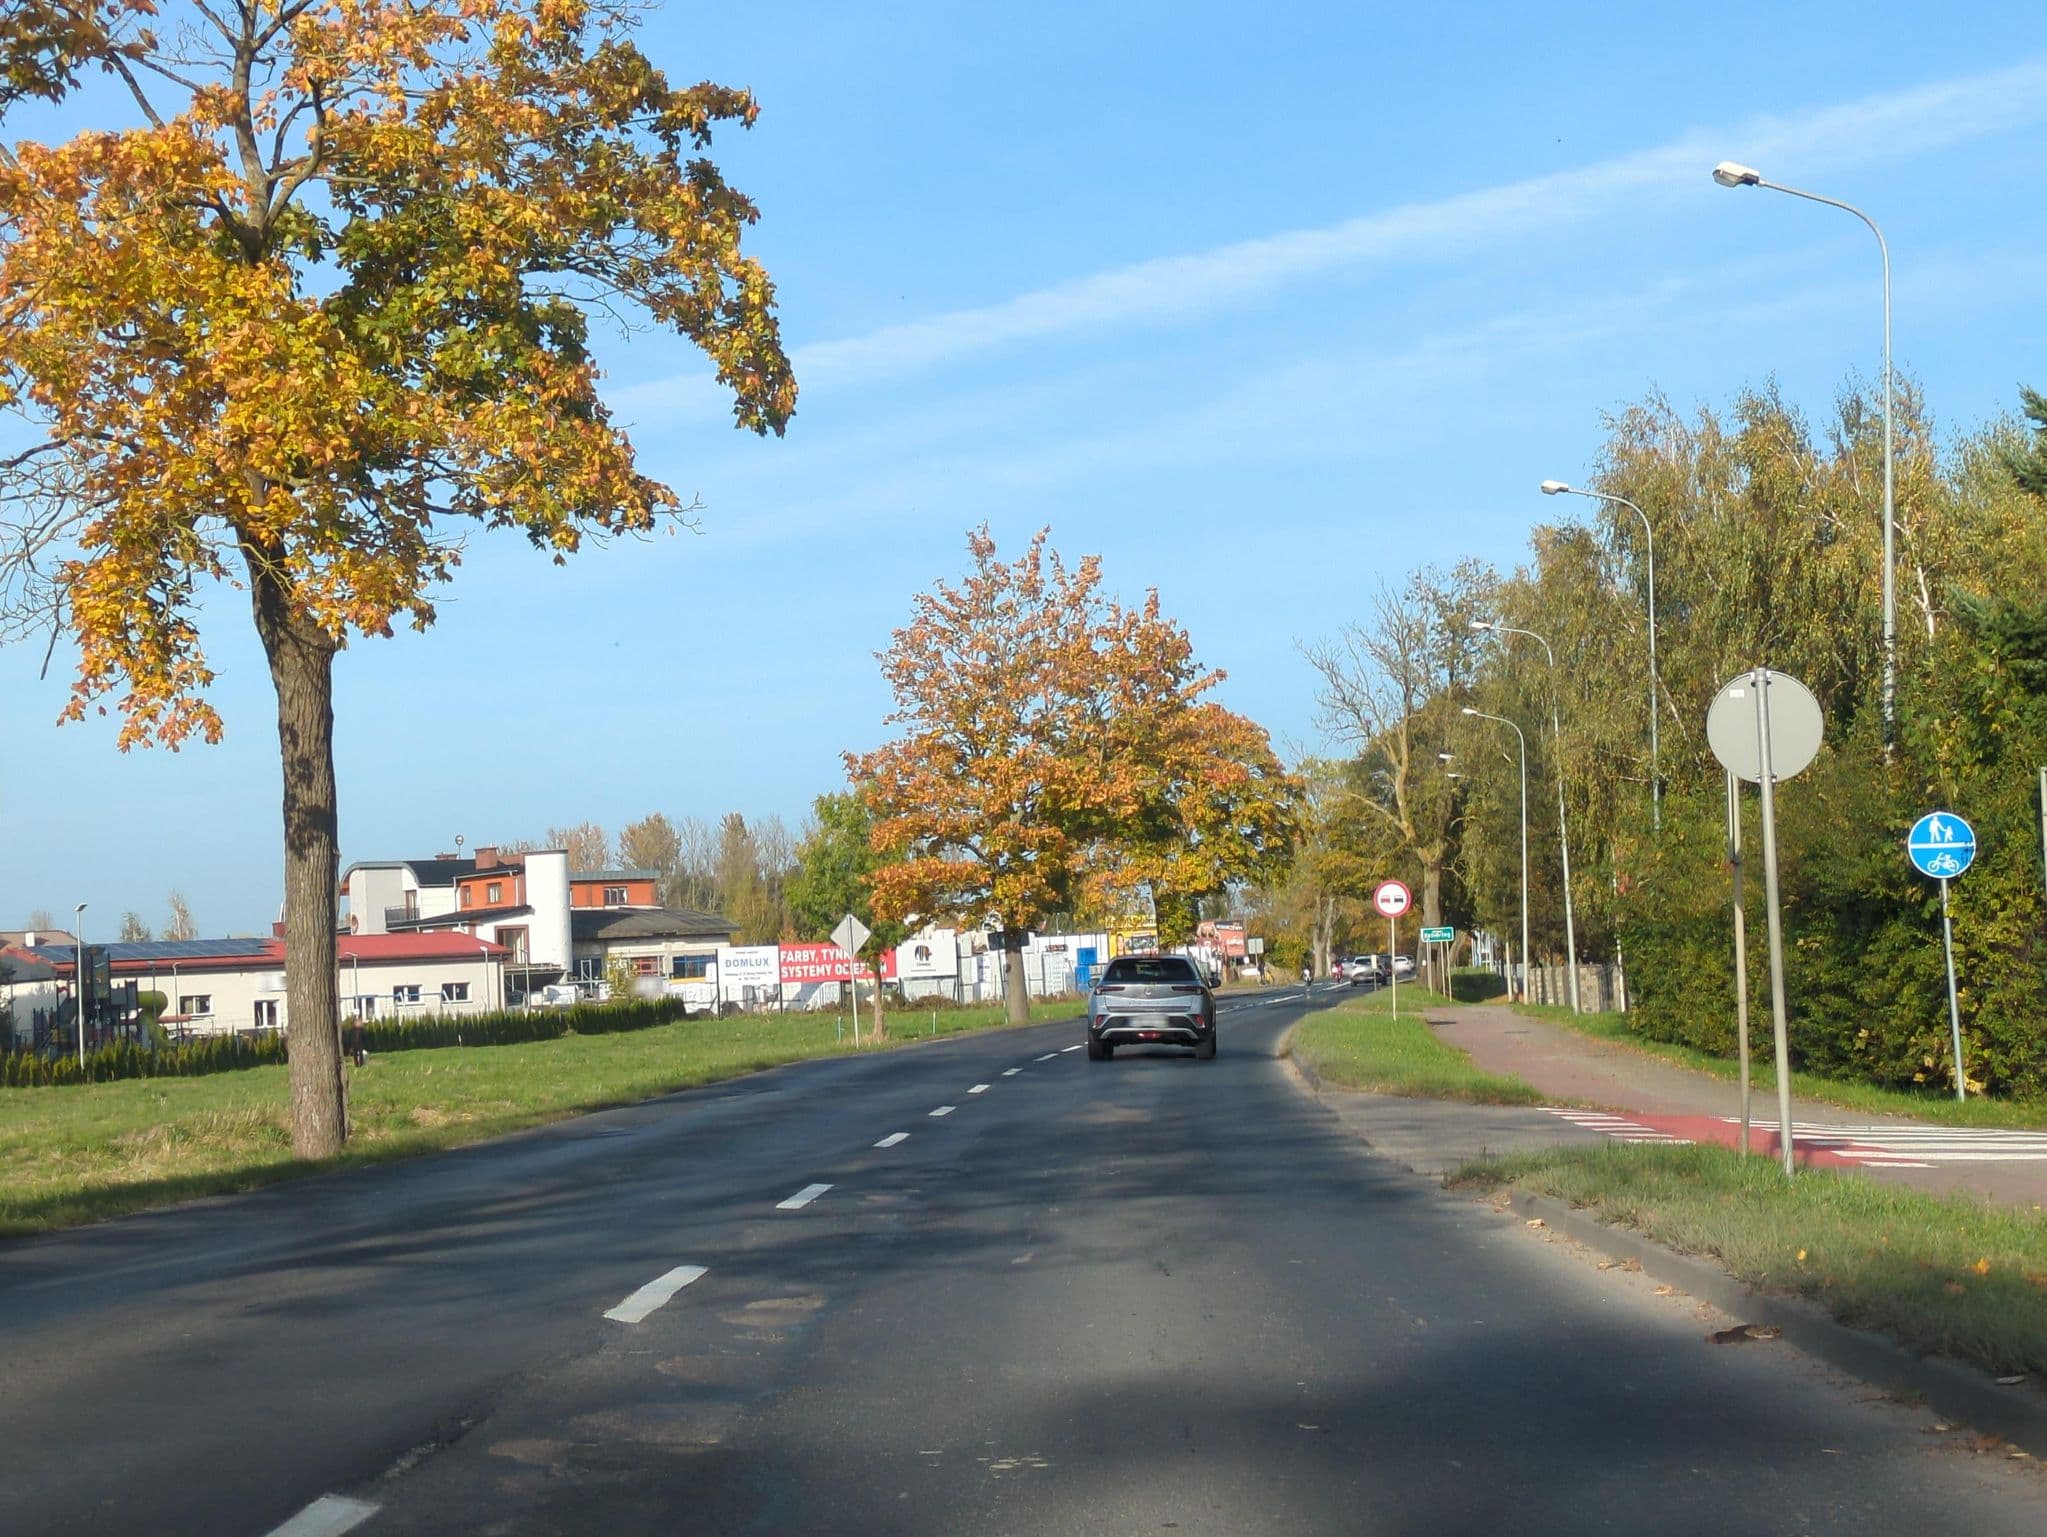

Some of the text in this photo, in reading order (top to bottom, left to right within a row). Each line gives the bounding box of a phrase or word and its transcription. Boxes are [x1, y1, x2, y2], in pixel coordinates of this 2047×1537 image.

[725, 957, 769, 968] DOMLUX
[780, 949, 819, 964] FARBY,
[780, 963, 833, 978] SYSTEMY
